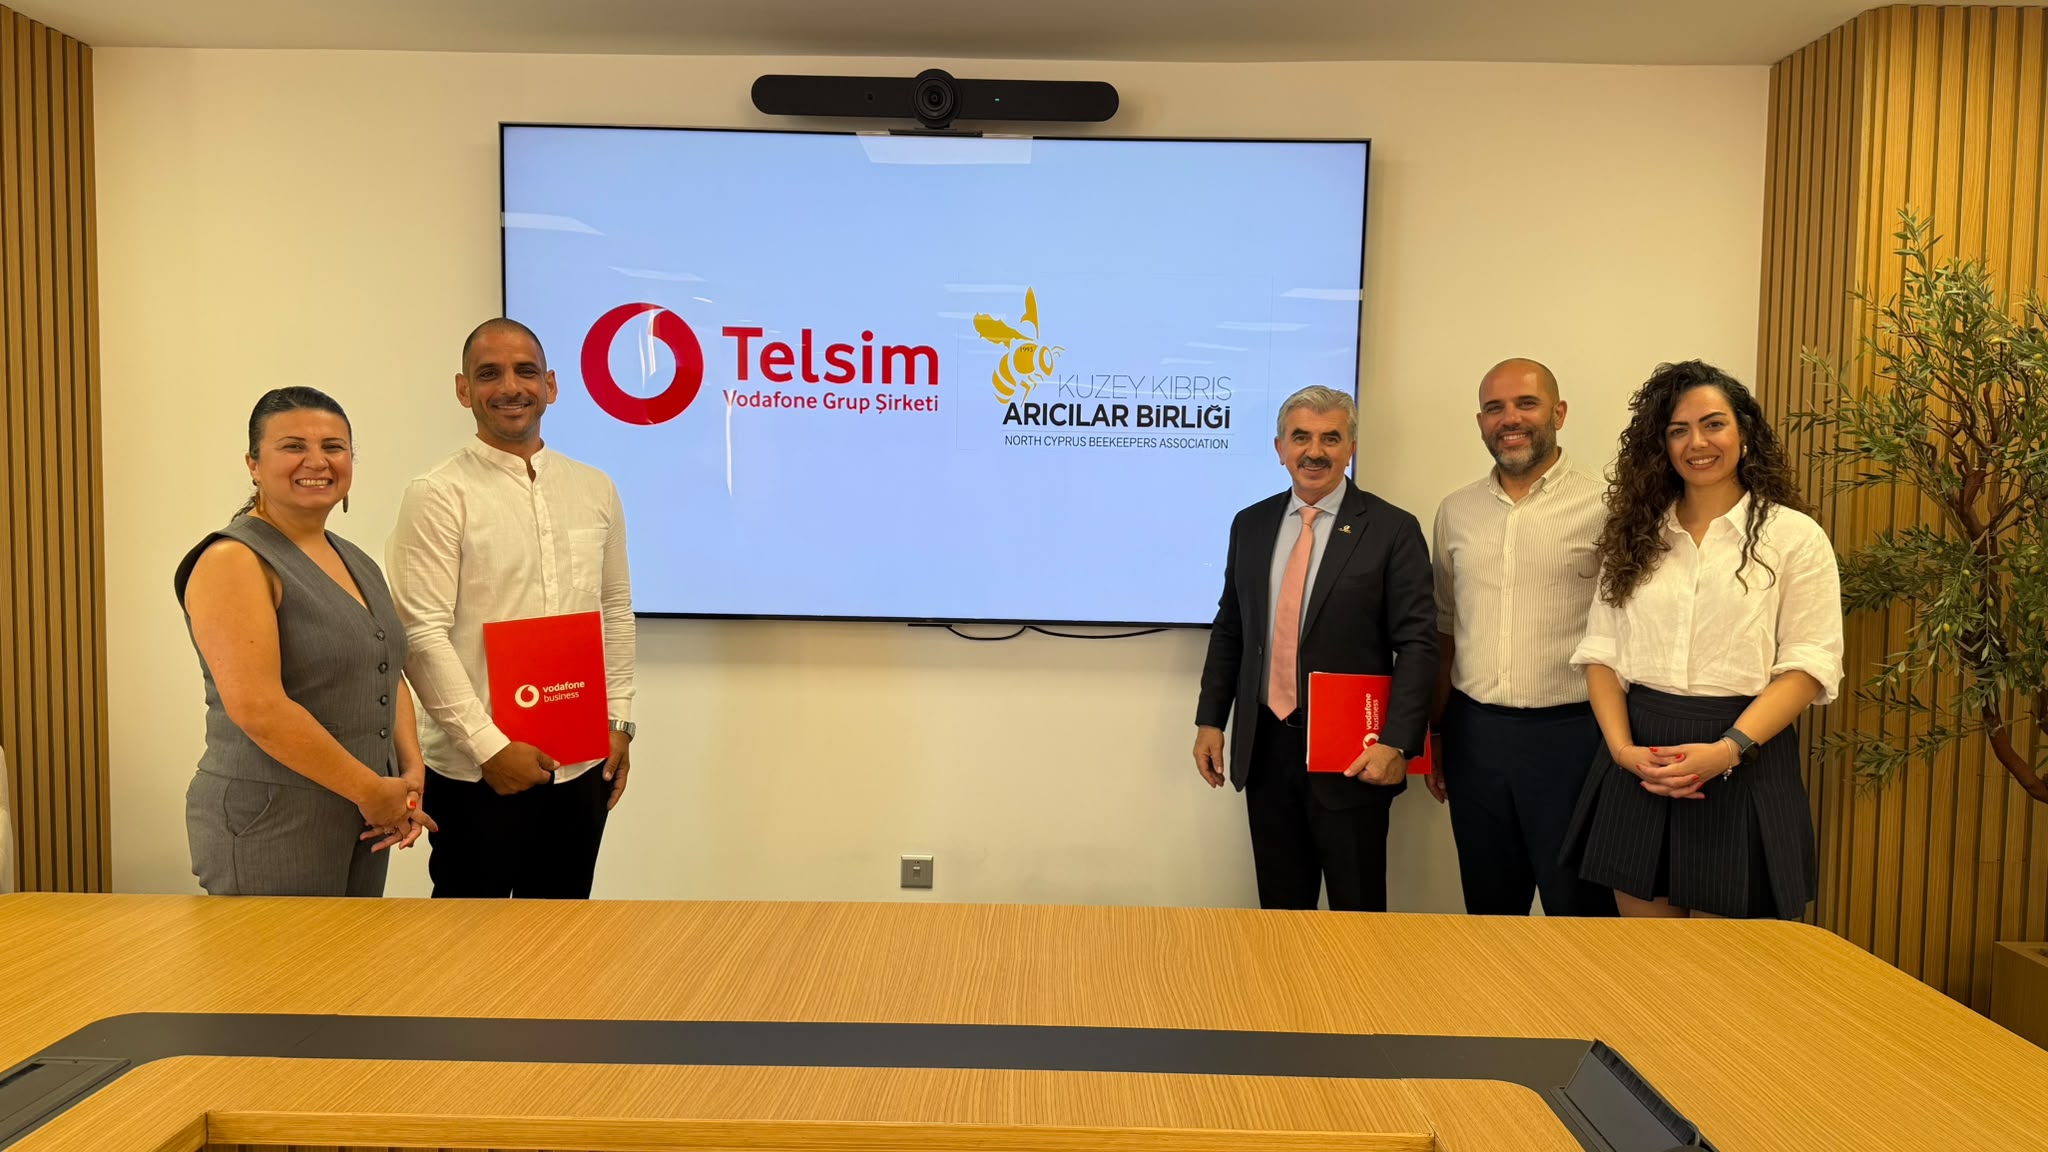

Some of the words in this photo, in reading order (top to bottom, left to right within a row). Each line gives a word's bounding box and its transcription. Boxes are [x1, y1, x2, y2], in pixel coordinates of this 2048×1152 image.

[722, 326, 939, 385] Telsim
[1058, 374, 1146, 399] KUZEY
[1152, 375, 1232, 401] KIBRIS
[722, 389, 818, 409] Vodafone
[823, 392, 871, 414] Grup
[875, 393, 939, 414] Şirketi
[1002, 402, 1129, 427] ARICILAR
[1005, 435, 1042, 446] NORTH
[1043, 435, 1087, 447] CYPRUS
[1089, 436, 1158, 448] BEEKEEPERS
[1159, 437, 1229, 449] ASSOCIATION
[542, 681, 585, 693] vodafone
[543, 691, 580, 703] business
[1364, 693, 1372, 730] vodafone
